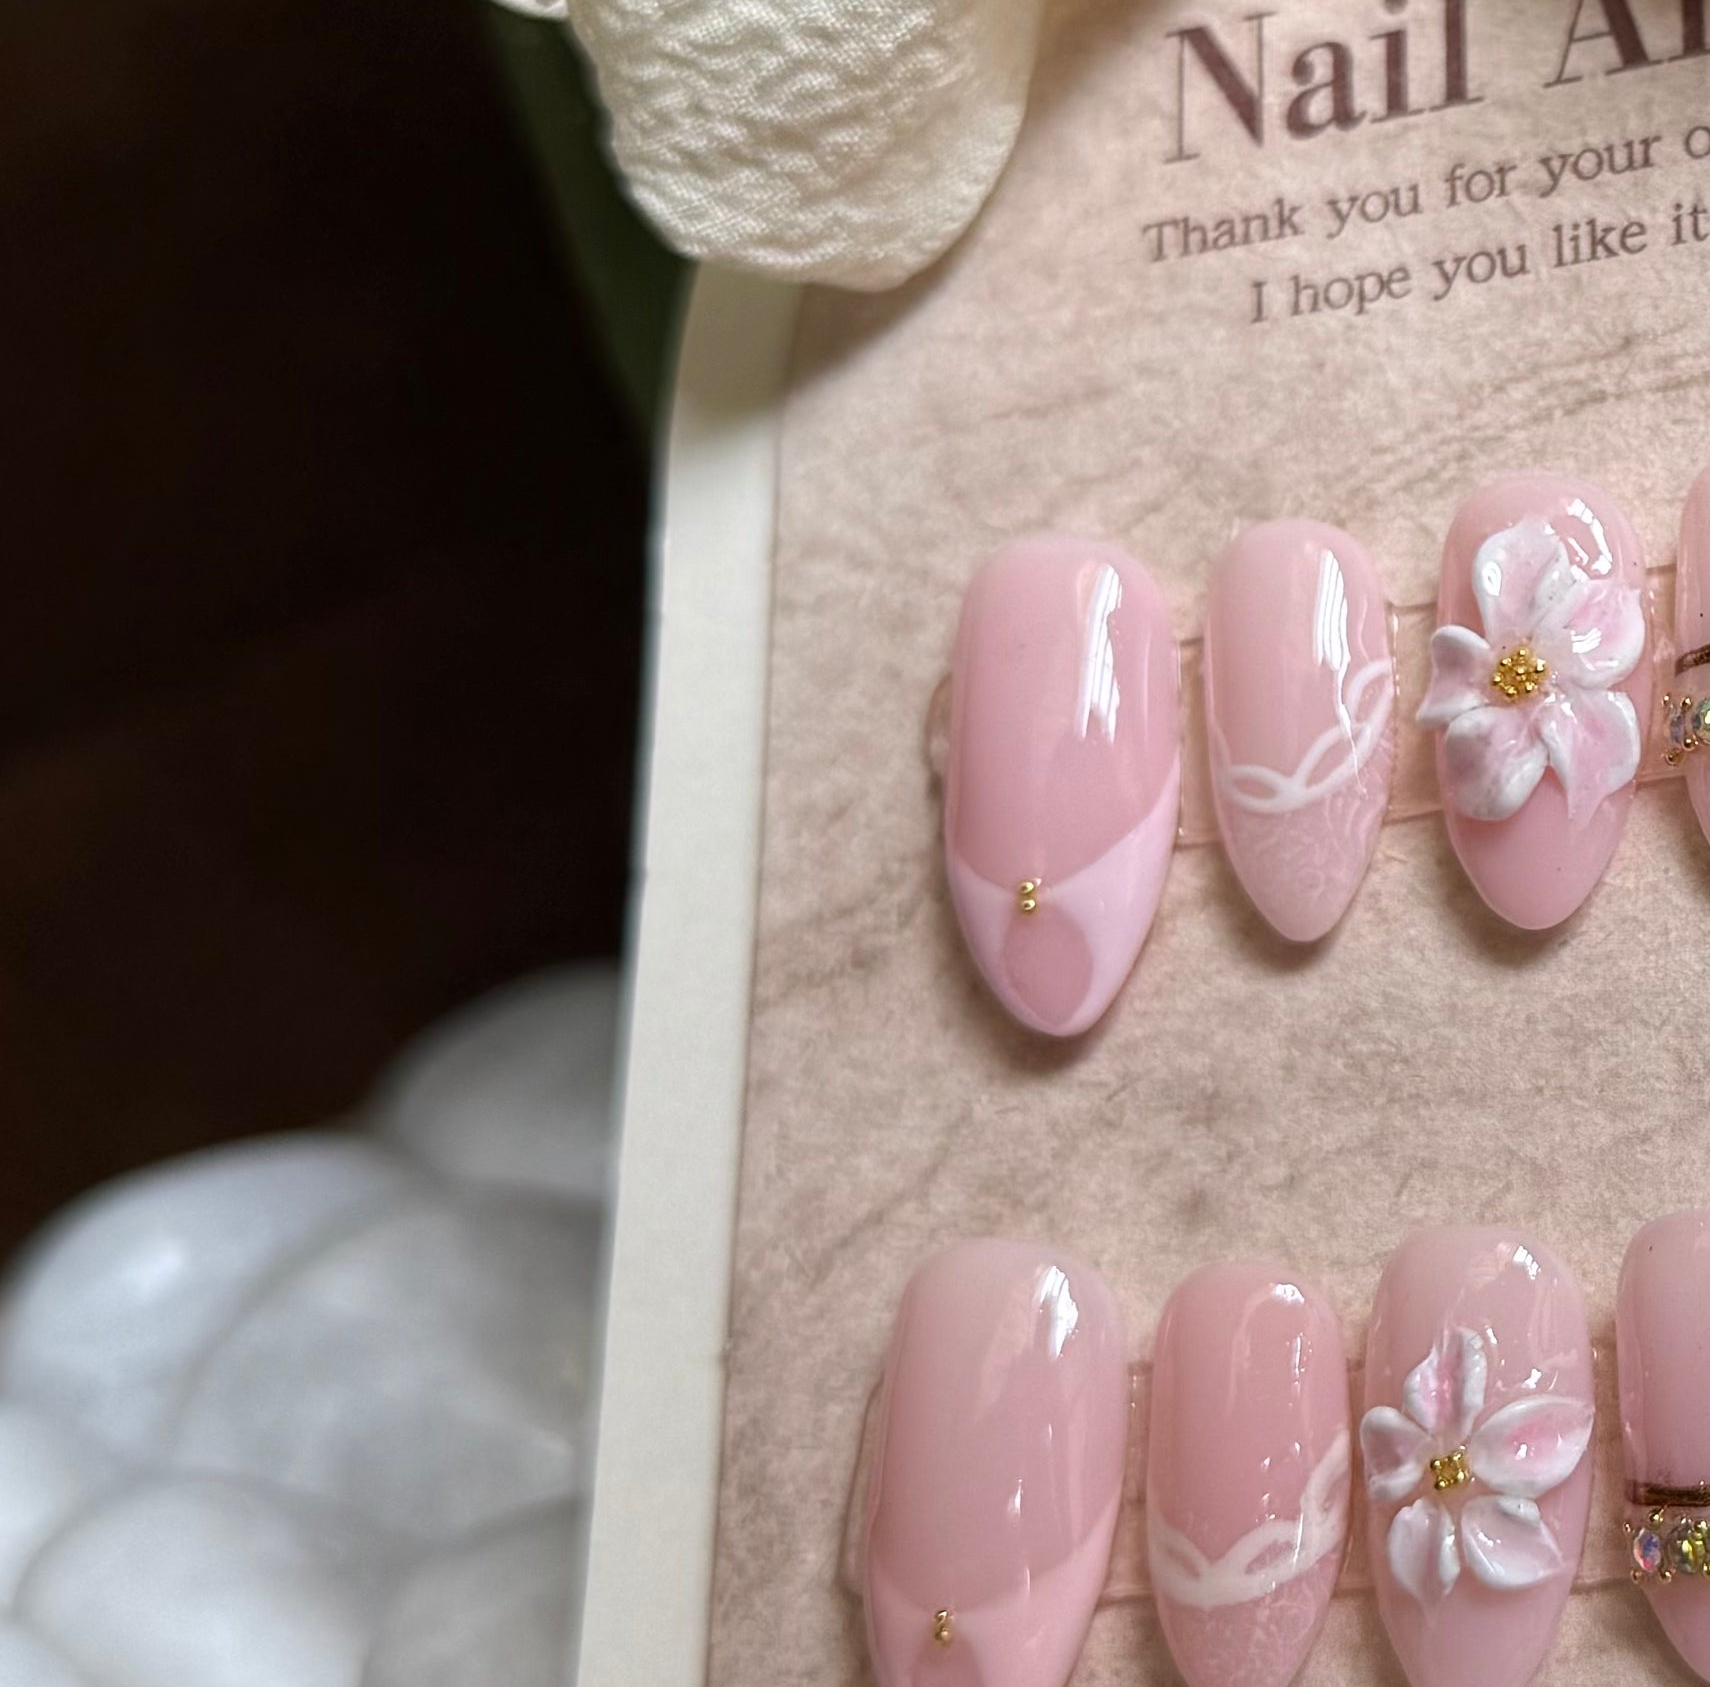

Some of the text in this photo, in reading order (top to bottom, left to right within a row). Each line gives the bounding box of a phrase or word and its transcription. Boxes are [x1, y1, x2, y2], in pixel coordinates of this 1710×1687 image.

[1142, 198, 1305, 263] Thank
[1326, 184, 1422, 240] you
[1443, 162, 1518, 208] for
[1536, 134, 1663, 198] your
[1249, 280, 1267, 324] I
[1289, 266, 1412, 316] hope
[1431, 244, 1530, 301] you
[1551, 217, 1649, 269] like
